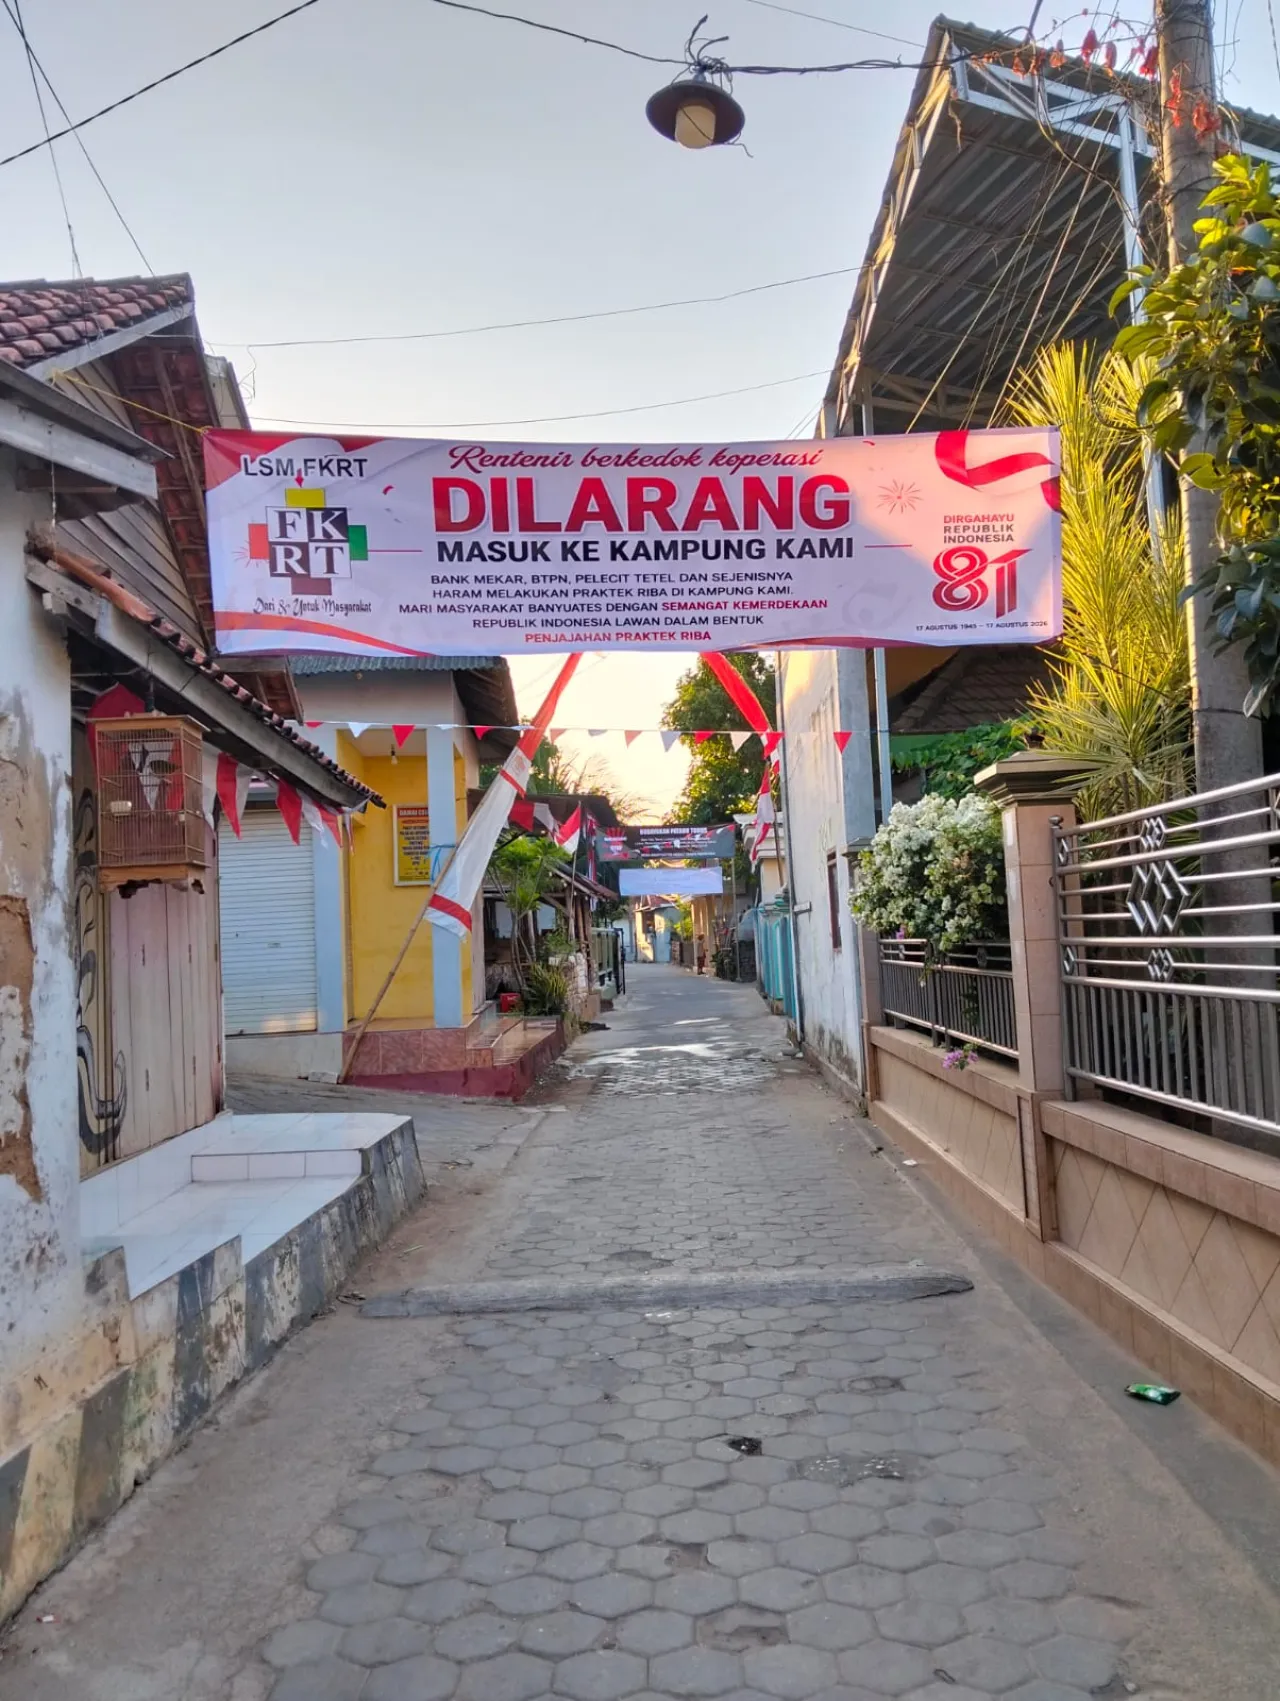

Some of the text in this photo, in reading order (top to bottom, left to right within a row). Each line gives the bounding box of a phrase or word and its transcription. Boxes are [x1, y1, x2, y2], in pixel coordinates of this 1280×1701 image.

[448, 445, 824, 475] Rentenir berkedok koperasi
[243, 457, 368, 477] LSM FKRT
[432, 474, 850, 533] DILARANG
[943, 514, 1015, 524] DIRGAHAYU
[943, 524, 1014, 534] REPUBLIK
[943, 534, 1015, 544] INDONESIA
[437, 537, 853, 562] MASUK KE KAMPUNG KAMI
[431, 572, 793, 585] BANK MEKAR, BTPN, PELECIT TETEL DAN SEJENISNYA
[932, 545, 1032, 619] 81
[433, 586, 794, 598] HARAM MELAKUKAN PRAKTEK RIBA DI KAMPUNG KAMI.
[399, 600, 828, 613] MARI MASYARAKAT BANYUATES DENGAN SEMANGAT KEMERDEKAAN
[472, 616, 764, 628] REPUBLIK INDONESIA LAWAN DALAM BENTUK
[524, 631, 712, 643] PENJAJAHAN PRAKTEK RIBA
